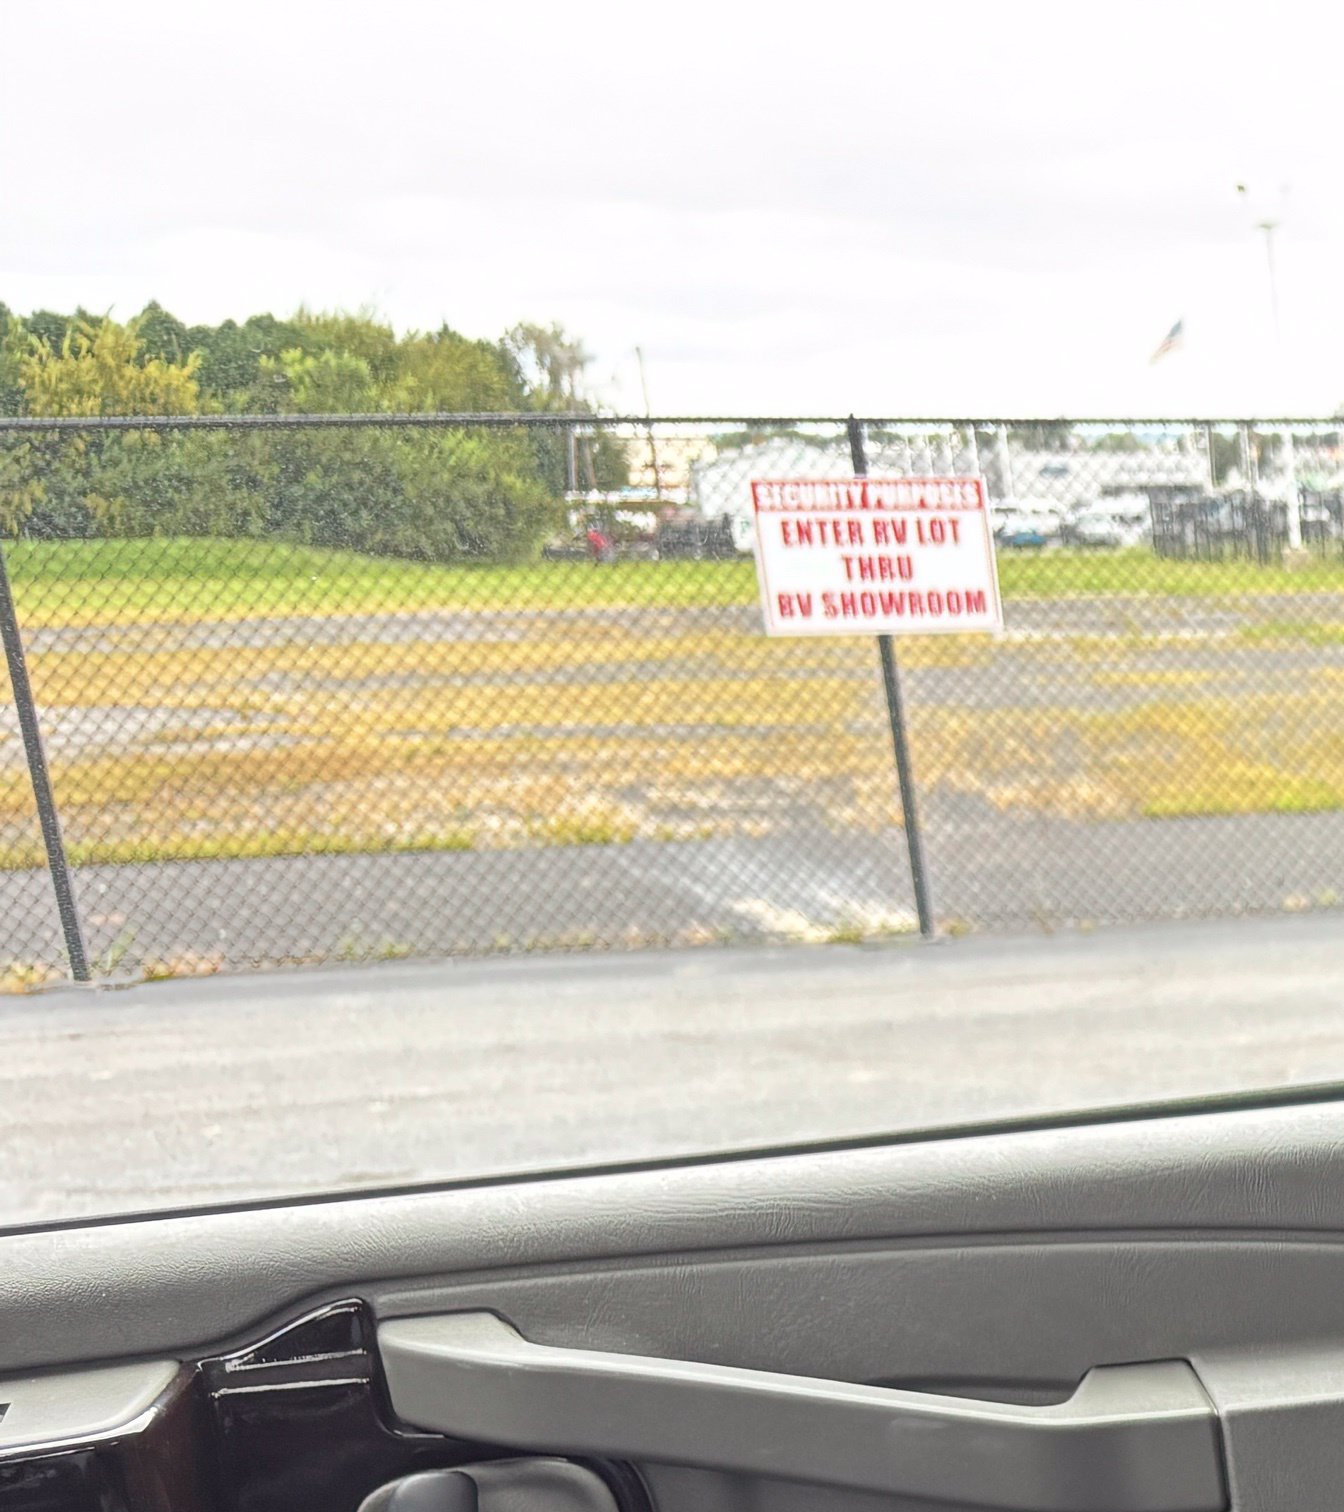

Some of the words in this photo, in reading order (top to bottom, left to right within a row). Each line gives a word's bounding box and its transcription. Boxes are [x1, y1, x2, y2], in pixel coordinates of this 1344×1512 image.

[756, 482, 863, 510] SECURITY
[867, 482, 978, 509] PURPOSES
[781, 518, 863, 546] ENTER
[872, 518, 907, 546] RV
[917, 517, 961, 545] LOT
[842, 555, 915, 581] THRU
[777, 592, 812, 618] RV
[822, 590, 986, 618] SHOWROOM
